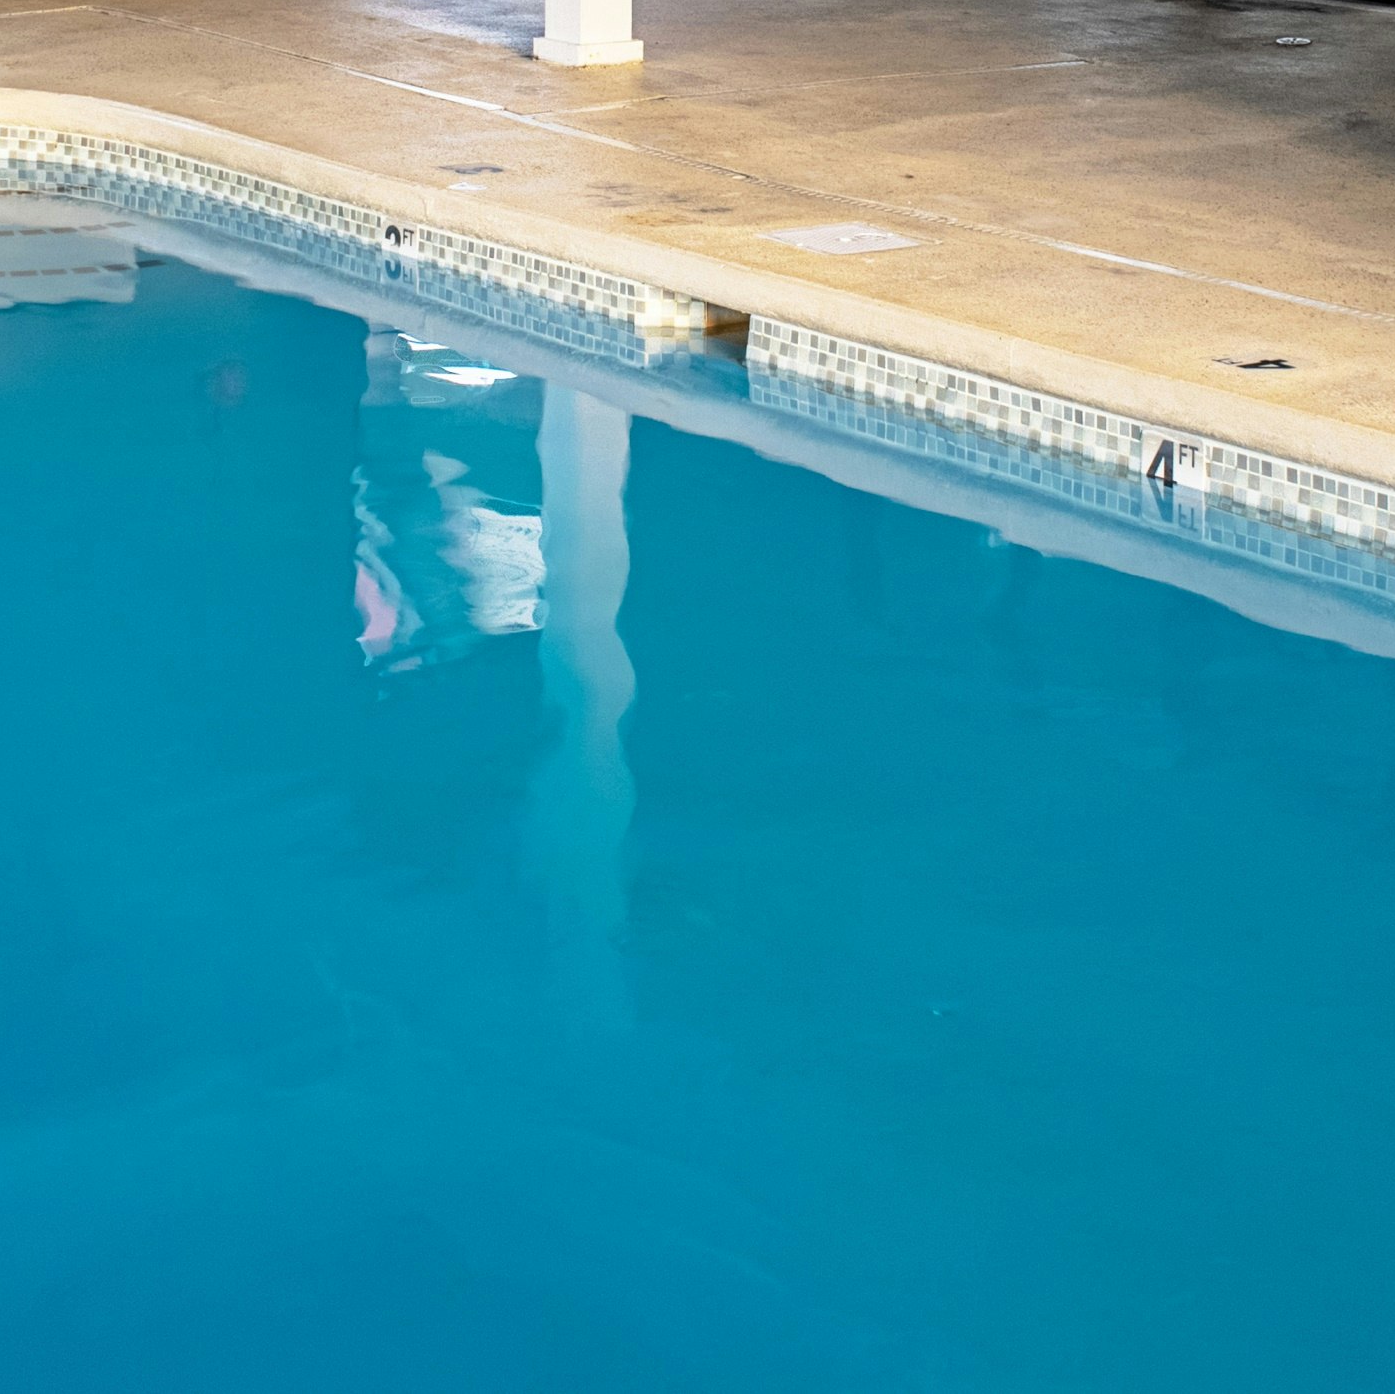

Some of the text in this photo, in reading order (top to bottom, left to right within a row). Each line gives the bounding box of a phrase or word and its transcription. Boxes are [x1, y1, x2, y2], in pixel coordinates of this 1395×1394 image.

[403, 228, 414, 246] FT
[1146, 439, 1199, 488] 4 FT
